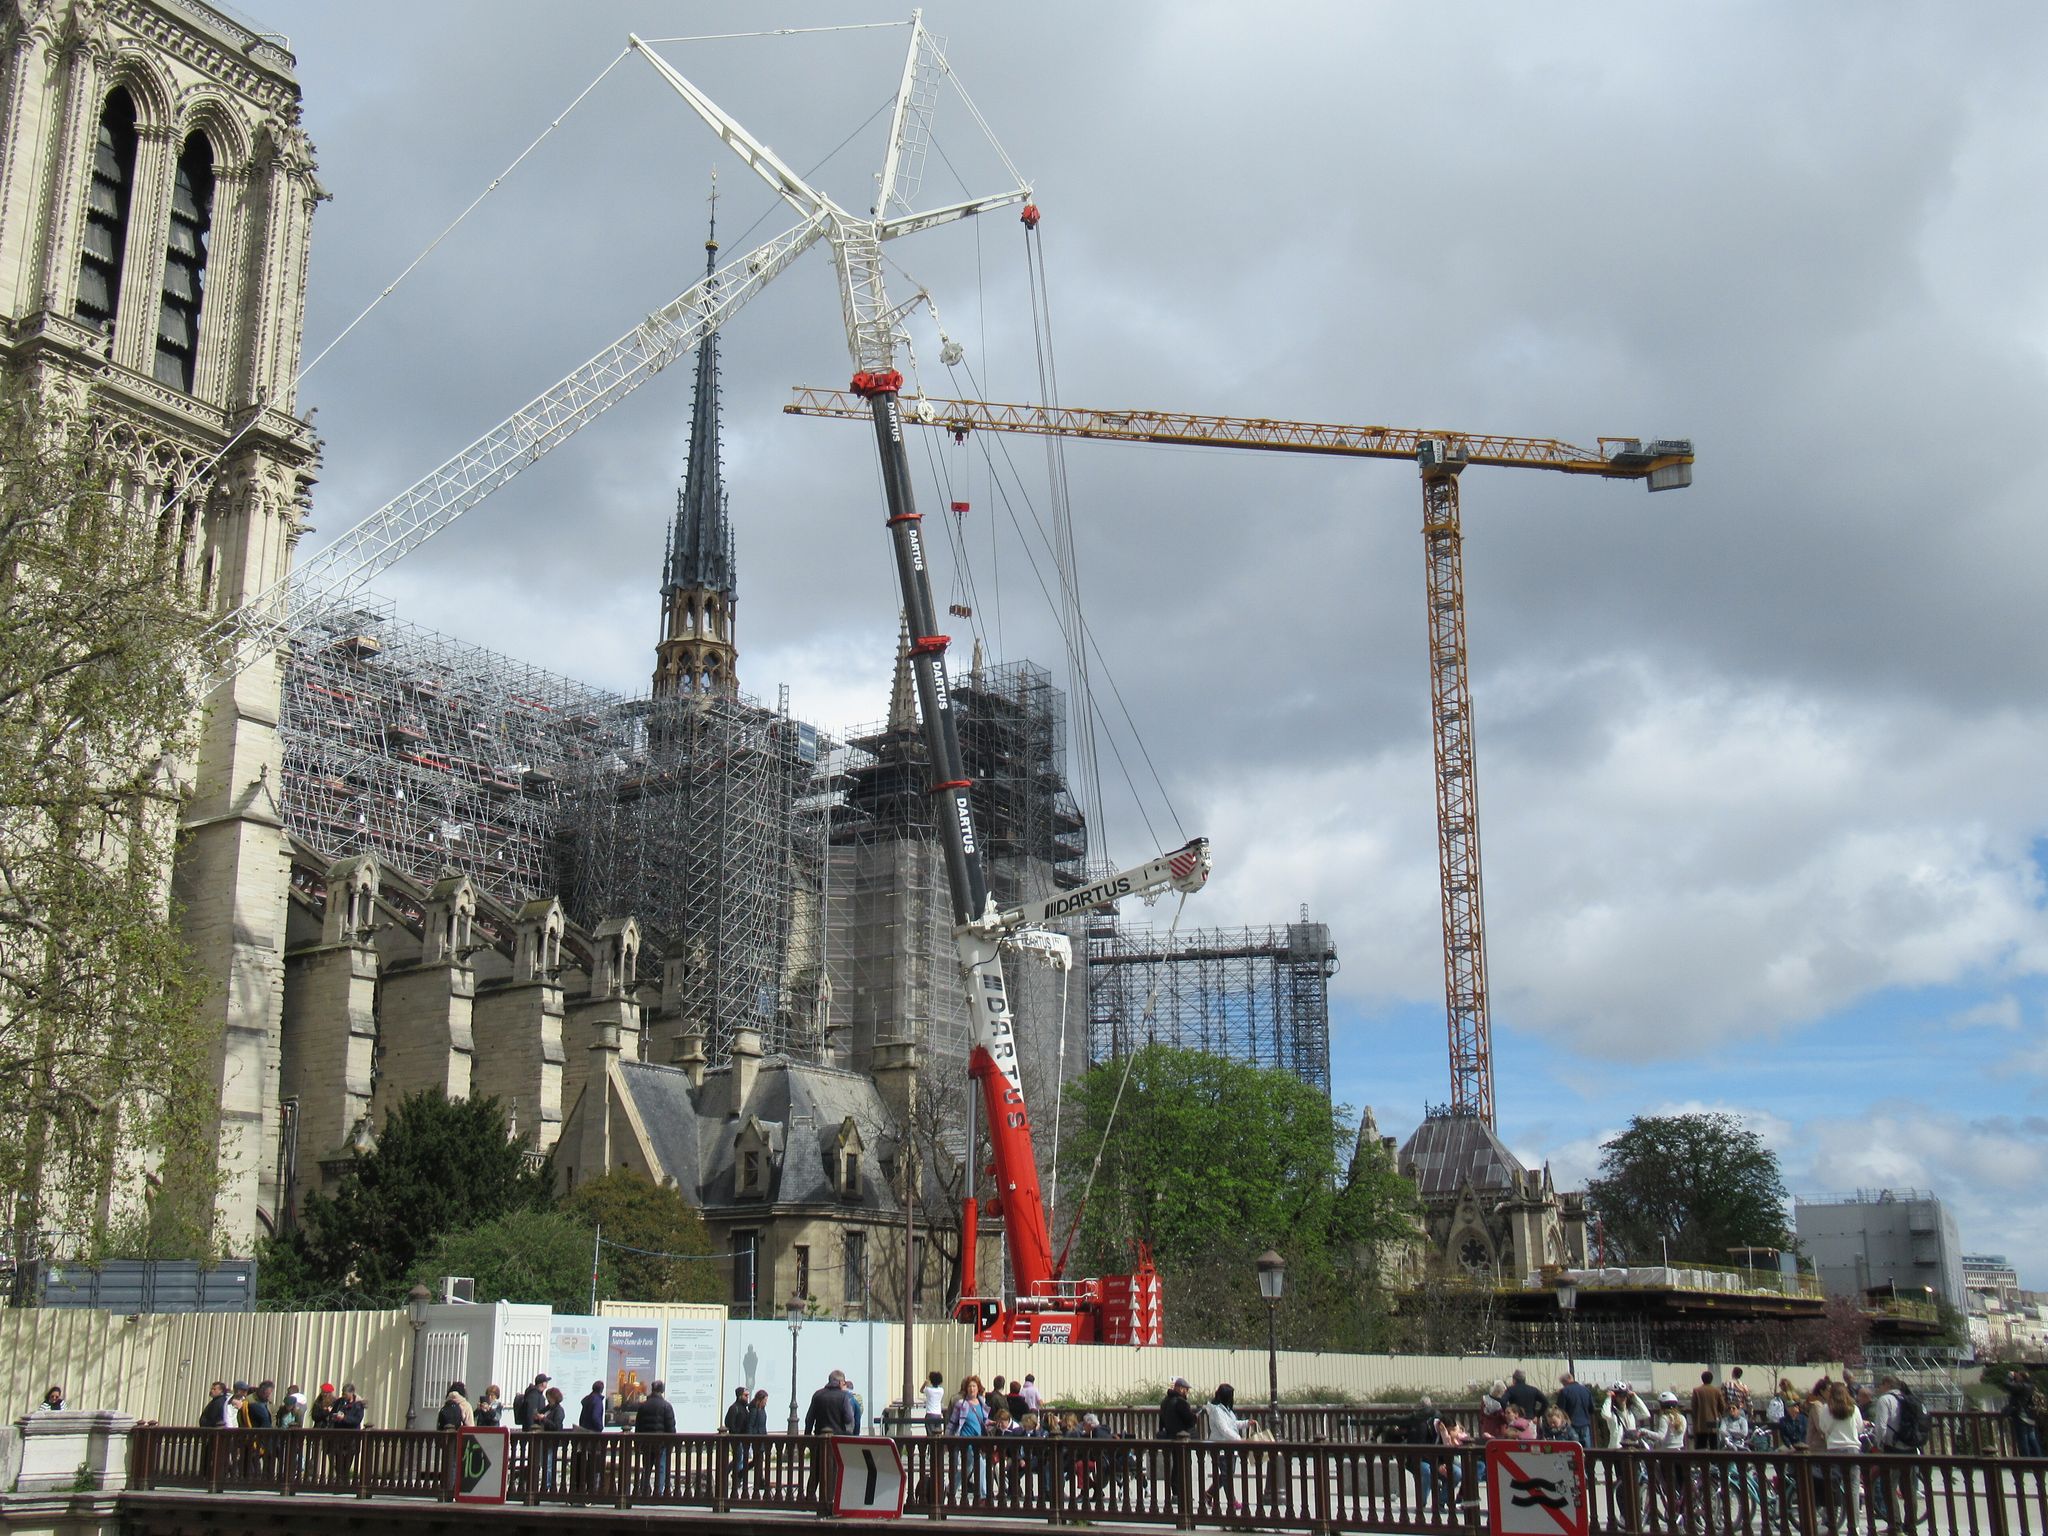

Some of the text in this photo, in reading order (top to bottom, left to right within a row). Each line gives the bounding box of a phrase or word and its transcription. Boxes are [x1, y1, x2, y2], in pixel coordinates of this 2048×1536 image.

[887, 402, 900, 442] DARTUS
[909, 530, 923, 571] DARTUS
[932, 661, 948, 710] DARTUS
[956, 797, 974, 854] DARTUS
[1057, 877, 1131, 915] DARTUS
[986, 997, 1026, 1129] DARTUS
[1038, 1335, 1068, 1344] LEVAGE
